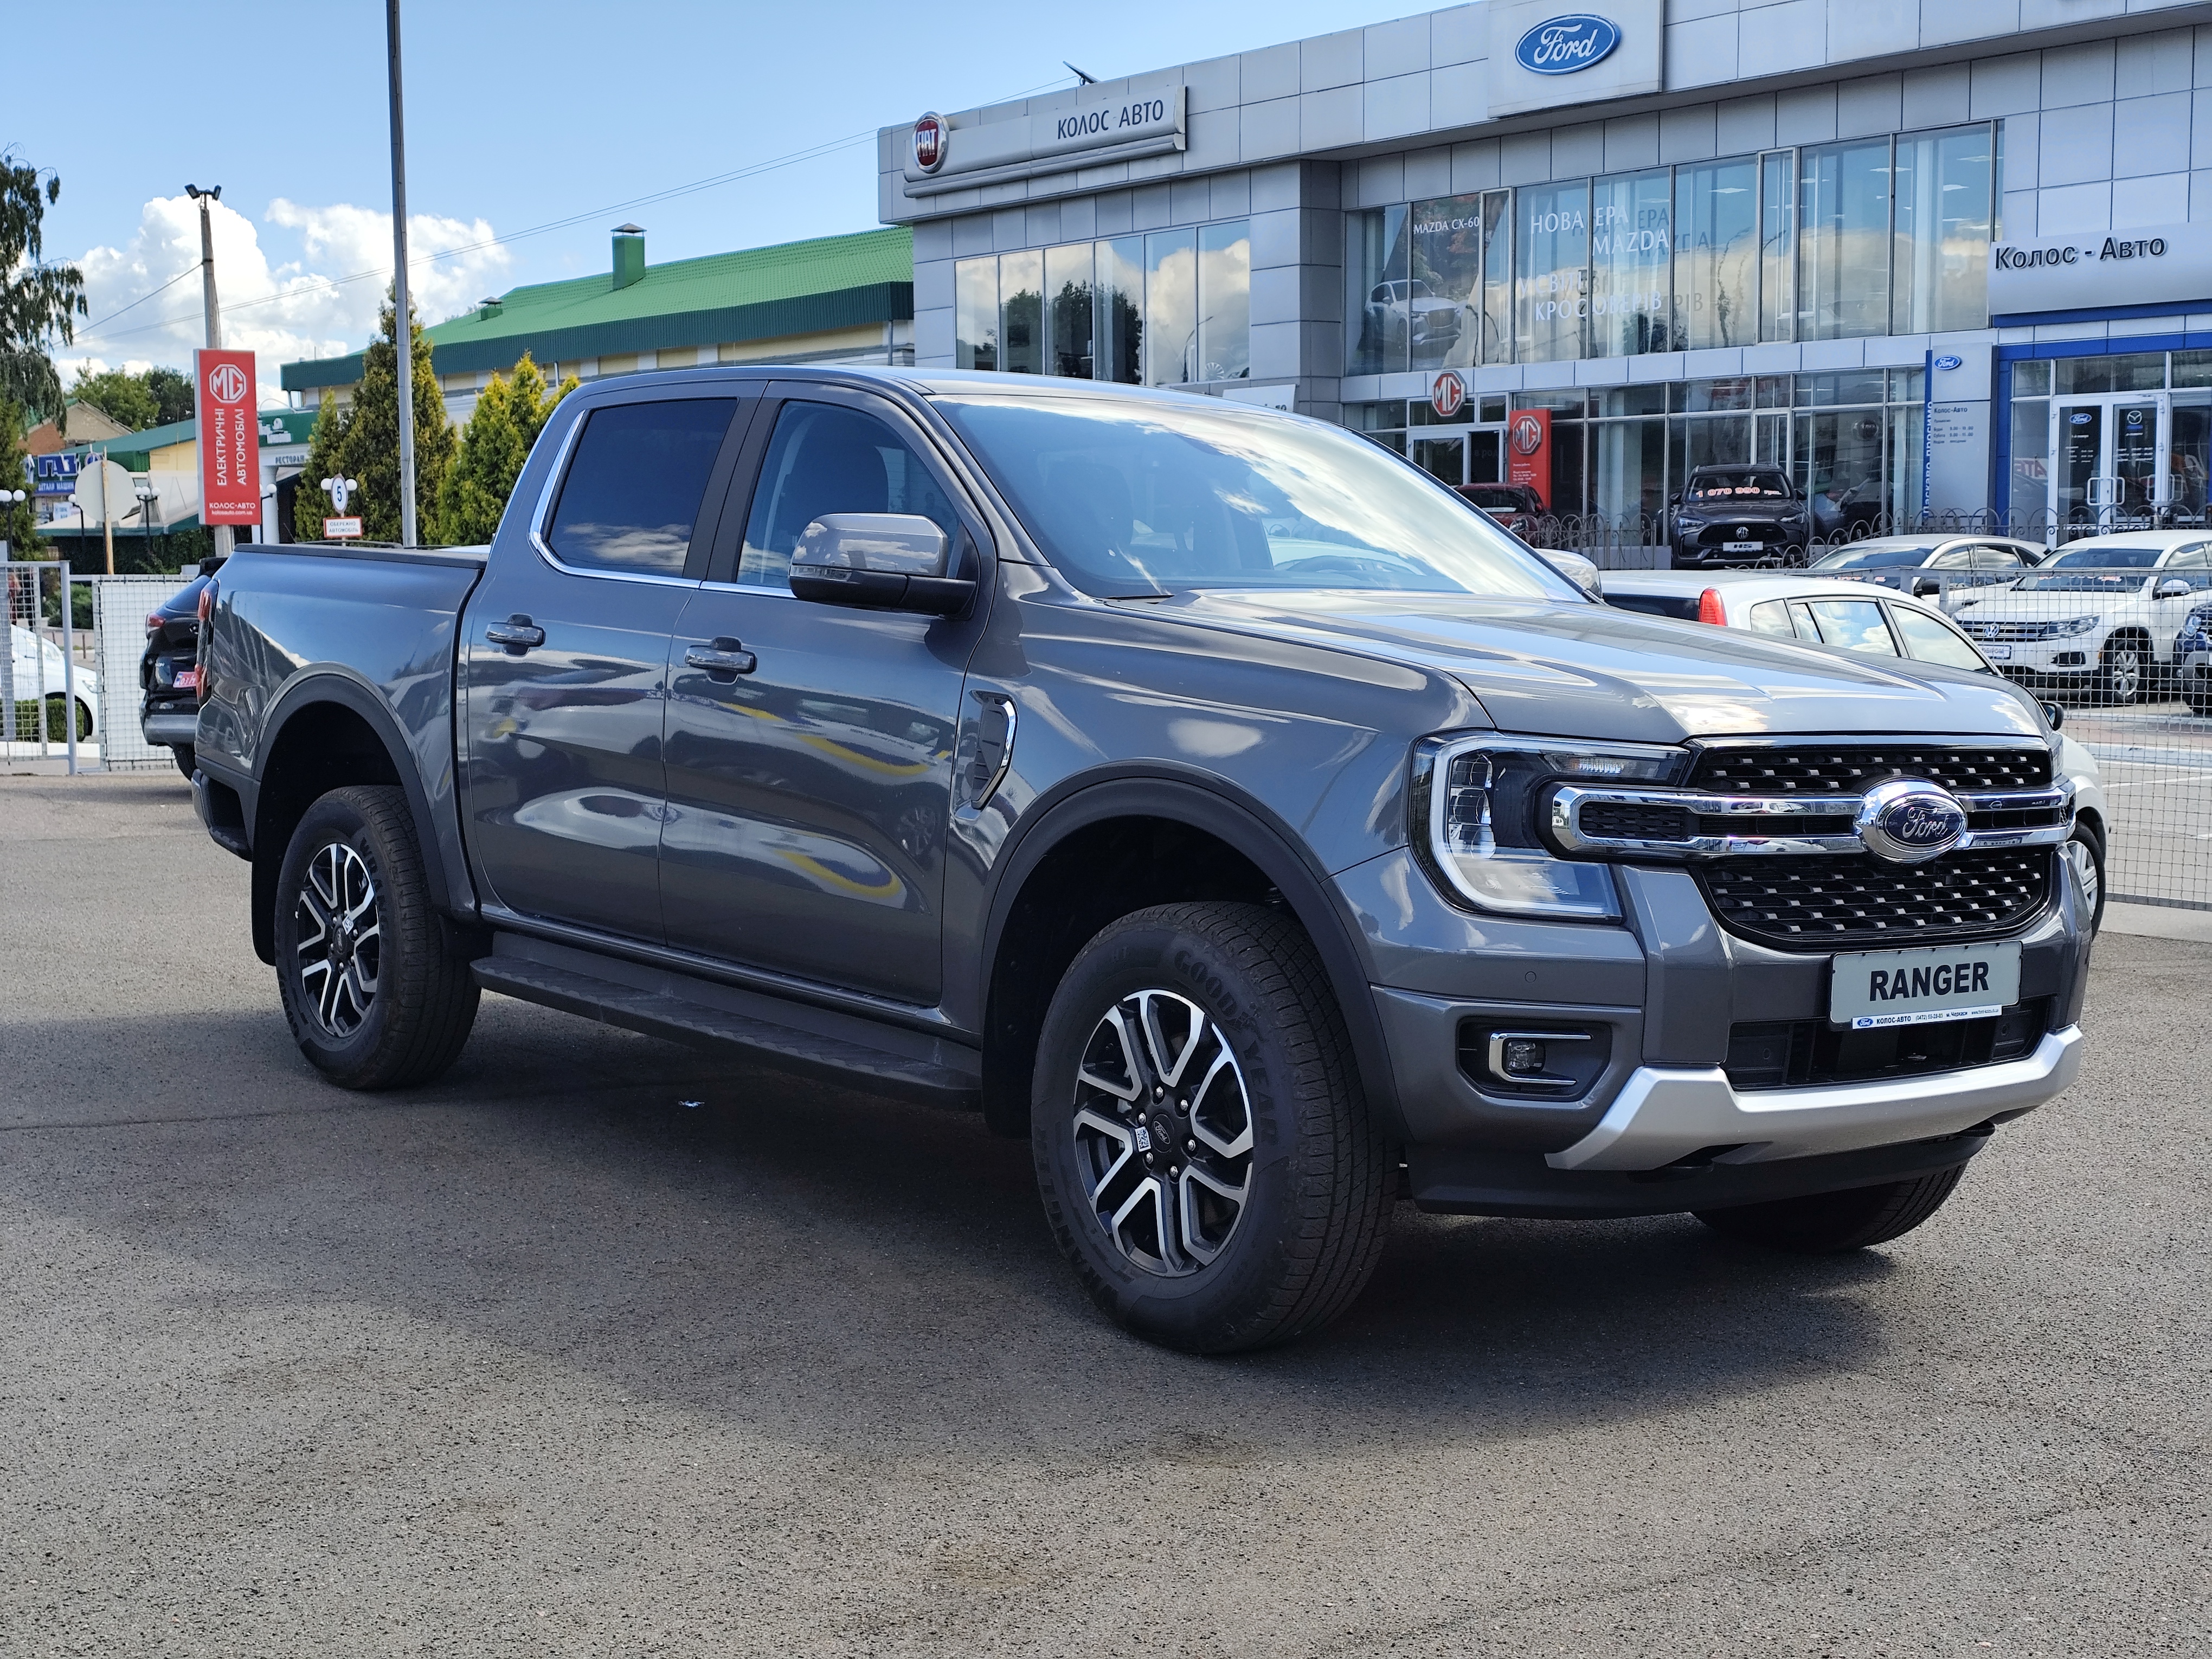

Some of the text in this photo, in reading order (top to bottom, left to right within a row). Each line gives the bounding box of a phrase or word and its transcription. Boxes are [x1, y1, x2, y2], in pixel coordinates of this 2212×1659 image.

[1534, 24, 1598, 64] Ford
[1058, 100, 1163, 139] КОЛОС АВТО
[917, 129, 937, 157] FIAT
[1414, 217, 1480, 234] MAZDA CX-60
[1531, 206, 1629, 234] НОВА ЕРА
[1592, 228, 1669, 256] MAZDA
[1996, 246, 2077, 270] Колос
[2100, 237, 2166, 260] Авто
[1535, 291, 1662, 321] КРОСОВЕРІВ
[213, 367, 243, 400] MG
[1434, 376, 1461, 412] MG
[215, 408, 227, 486] ЕЛЕКТРИЧНІ
[235, 408, 247, 485] АВТОМОБІЛІ
[1516, 420, 1537, 450] MG
[275, 455, 305, 464] РЕСТОРАН
[337, 486, 342, 502] 5
[1707, 487, 1732, 496] 070
[1737, 527, 1749, 539] MG
[1902, 807, 1950, 838] Ford
[1869, 961, 1989, 1001] RANGER
[1876, 1015, 1911, 1024] КОЛОС-АВТО
